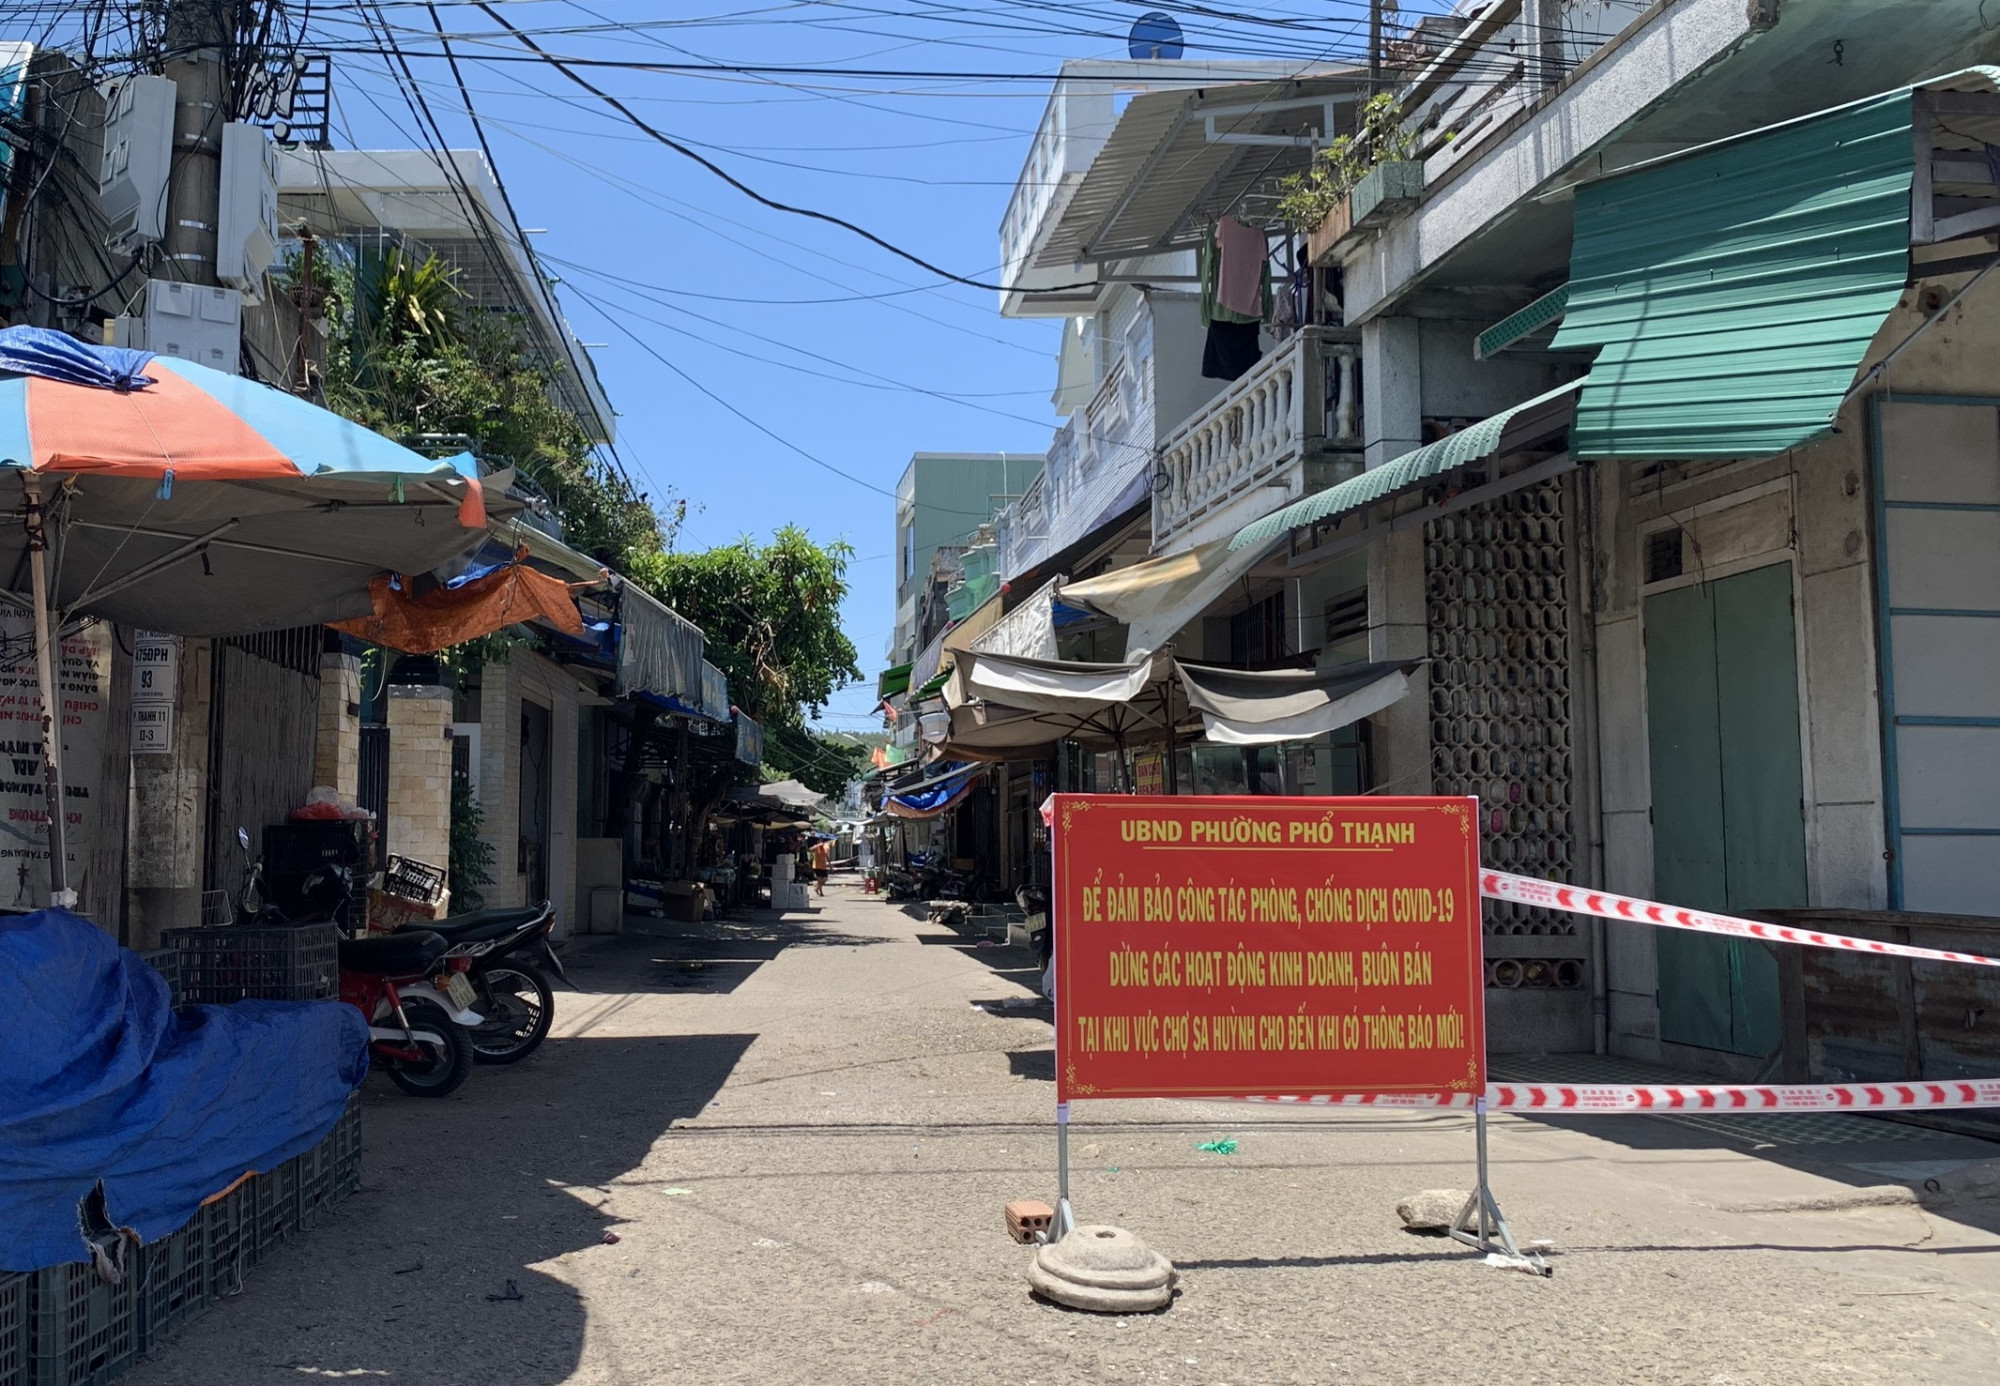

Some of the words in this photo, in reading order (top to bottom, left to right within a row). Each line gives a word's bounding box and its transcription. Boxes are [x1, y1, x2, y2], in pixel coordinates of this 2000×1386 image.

[141, 670, 152, 688] 93
[1120, 820, 1183, 842] UBND
[1190, 814, 1282, 844] PHƯỜNG
[1288, 810, 1334, 844] PHỔ
[1340, 822, 1416, 848] THẠNH
[1082, 867, 1103, 922] ĐỂ
[1106, 872, 1140, 922] ĐẢM
[1143, 872, 1174, 922] BẢO
[1176, 877, 1216, 923] CÔNG
[1218, 877, 1246, 922] TÁC
[1250, 877, 1302, 930] PHÒNG,
[1304, 873, 1353, 923] CHỐNG
[1356, 888, 1388, 932] DỊCH
[1392, 887, 1455, 923] COVID-19
[1109, 941, 1149, 987] DỪNG
[1152, 941, 1182, 987] CÁC
[1185, 950, 1222, 995] HOẠT
[1226, 941, 1266, 994] ĐỘNG
[1268, 951, 1303, 987] KINH
[1306, 951, 1358, 994] DOANH,
[1361, 941, 1400, 987] BUÔN
[1403, 941, 1433, 986] BÁN
[1078, 1016, 1100, 1060] TẠI
[1103, 1016, 1130, 1052] KHU
[1133, 1008, 1160, 1060] VỰC
[1162, 1010, 1190, 1060] CHỢ
[1192, 1015, 1210, 1052] SA
[1212, 1006, 1256, 1052] HUỲNH
[1258, 1014, 1285, 1051] CHO
[1288, 1001, 1314, 1050] ĐẾN
[1318, 1014, 1340, 1050] KHI
[1342, 1005, 1360, 1050] CÓ
[1362, 1005, 1406, 1050] THÔNG
[1407, 1004, 1434, 1050] BÁO
[1436, 1004, 1464, 1050] MỚI!
